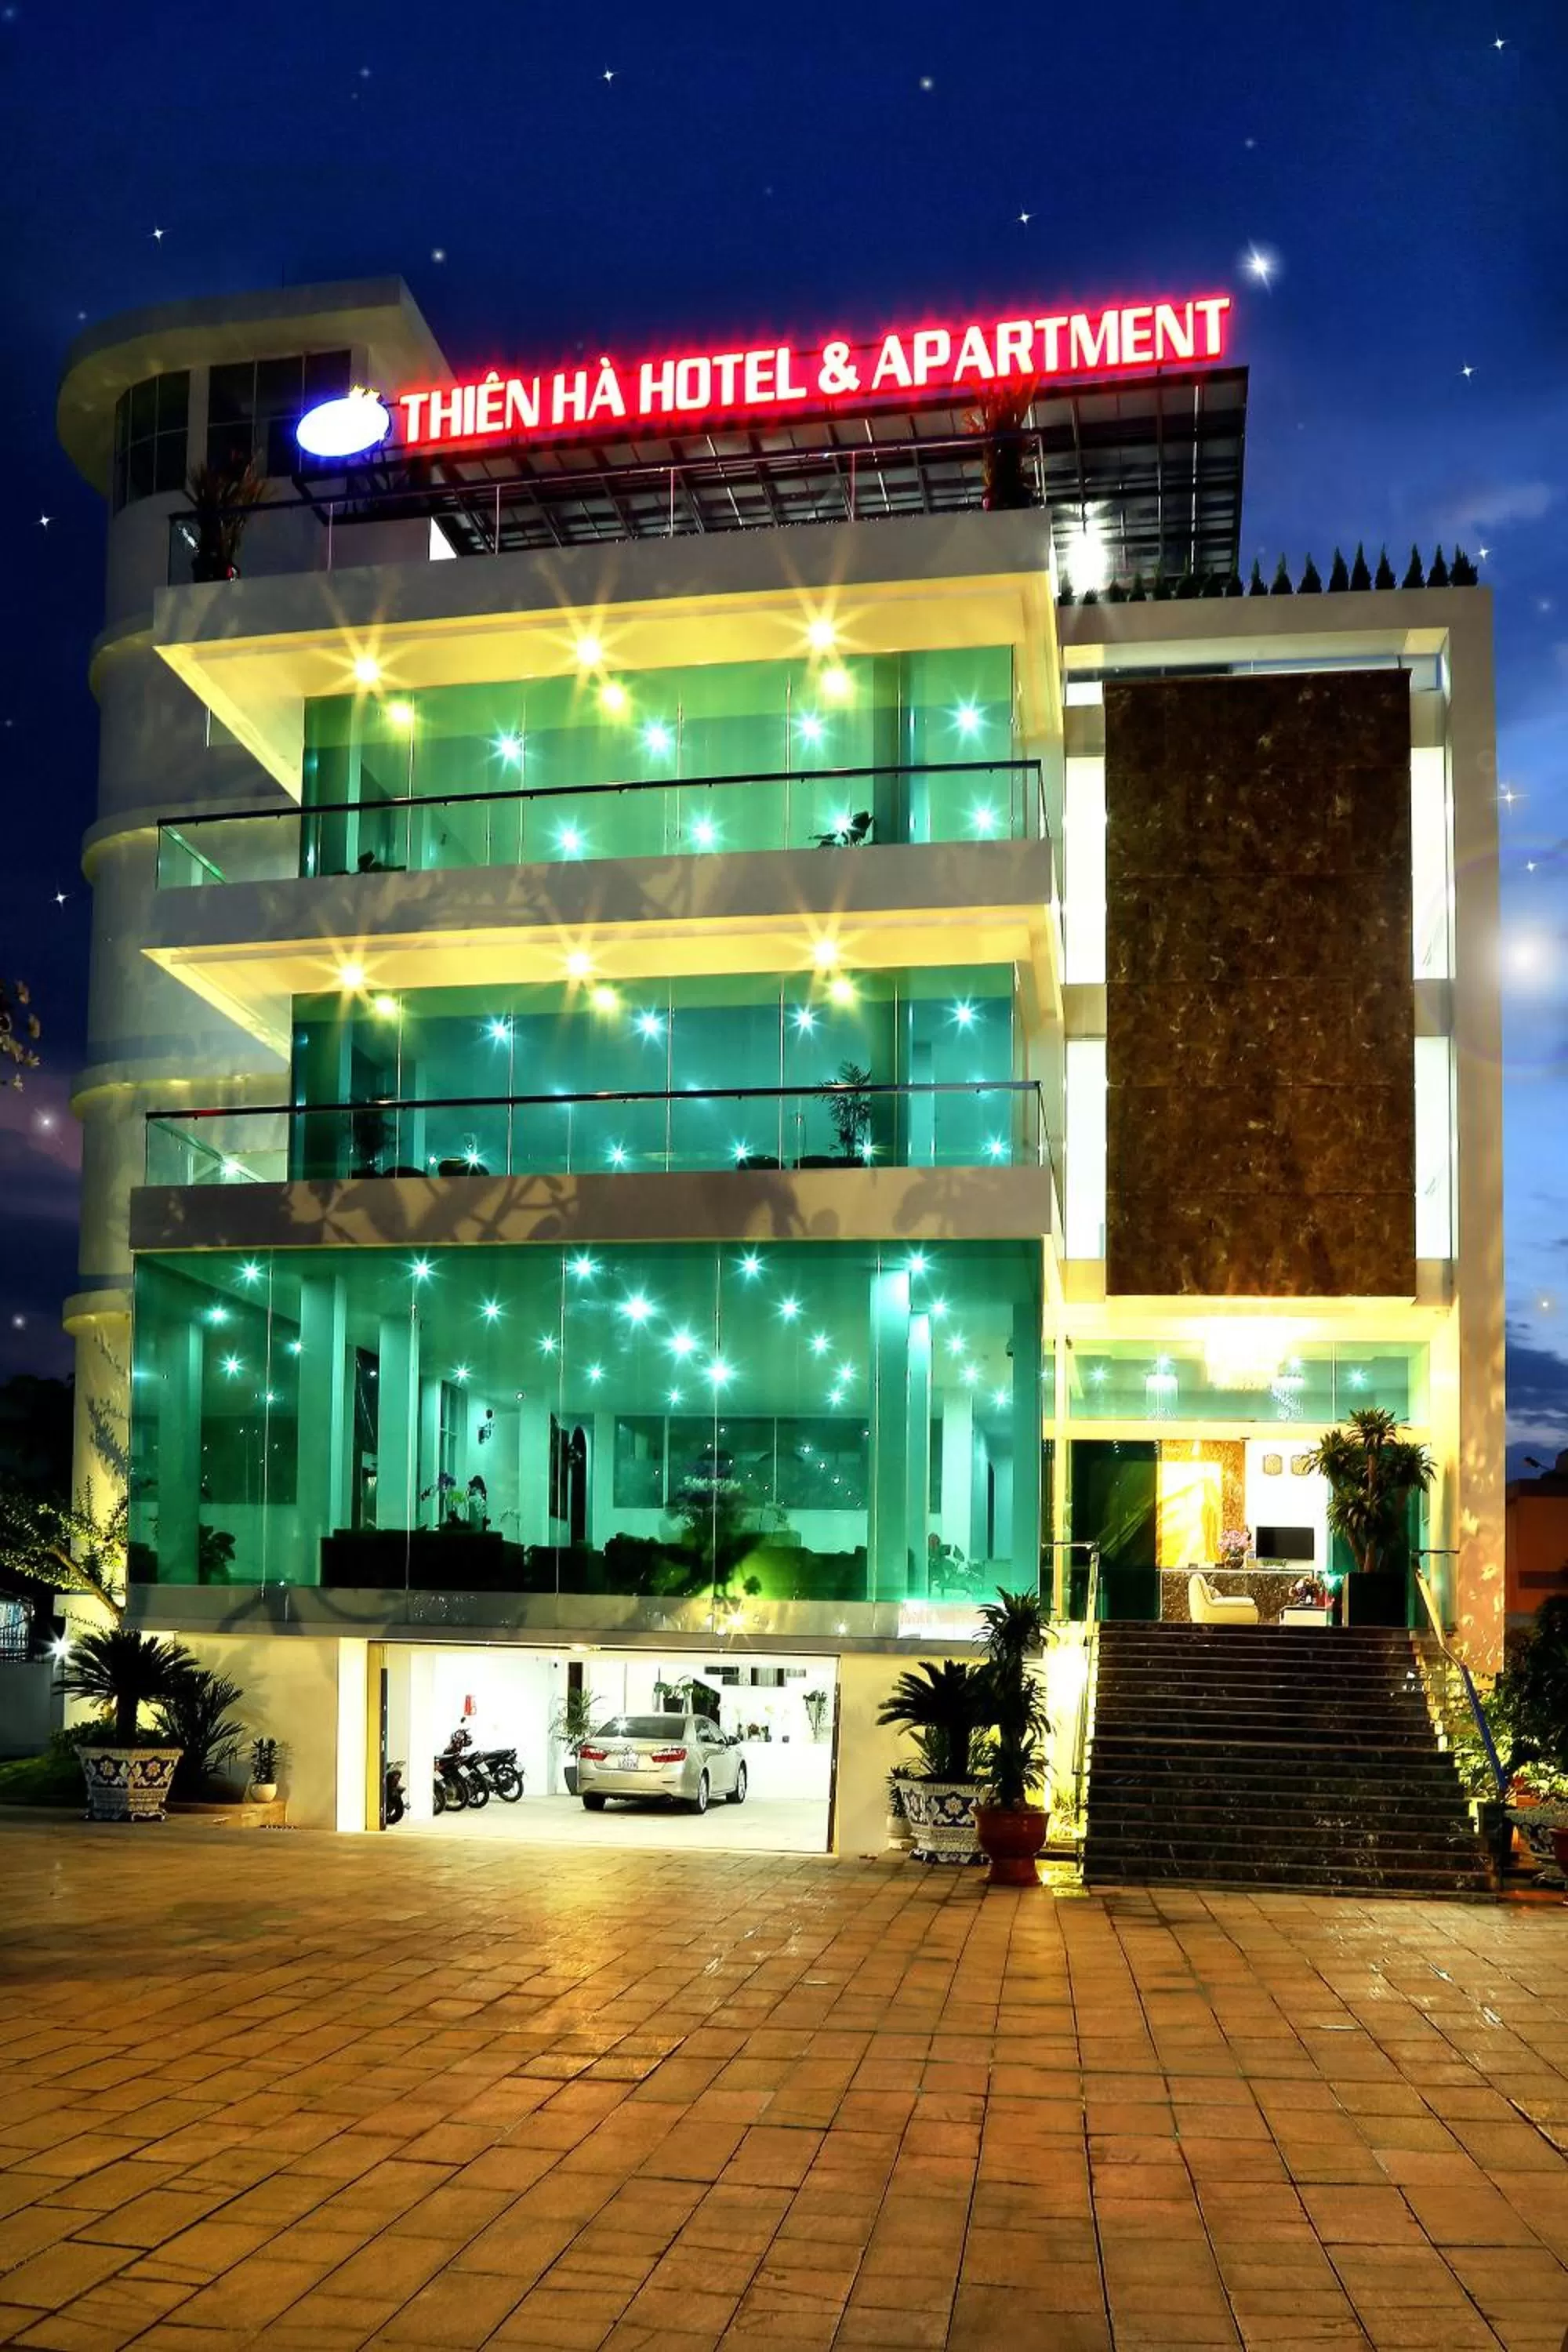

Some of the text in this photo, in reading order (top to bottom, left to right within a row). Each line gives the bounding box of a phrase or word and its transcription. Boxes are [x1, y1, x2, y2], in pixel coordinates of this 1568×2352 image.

[399, 297, 1230, 443] THIÊN HÀ HOTEL & APARTMENT
